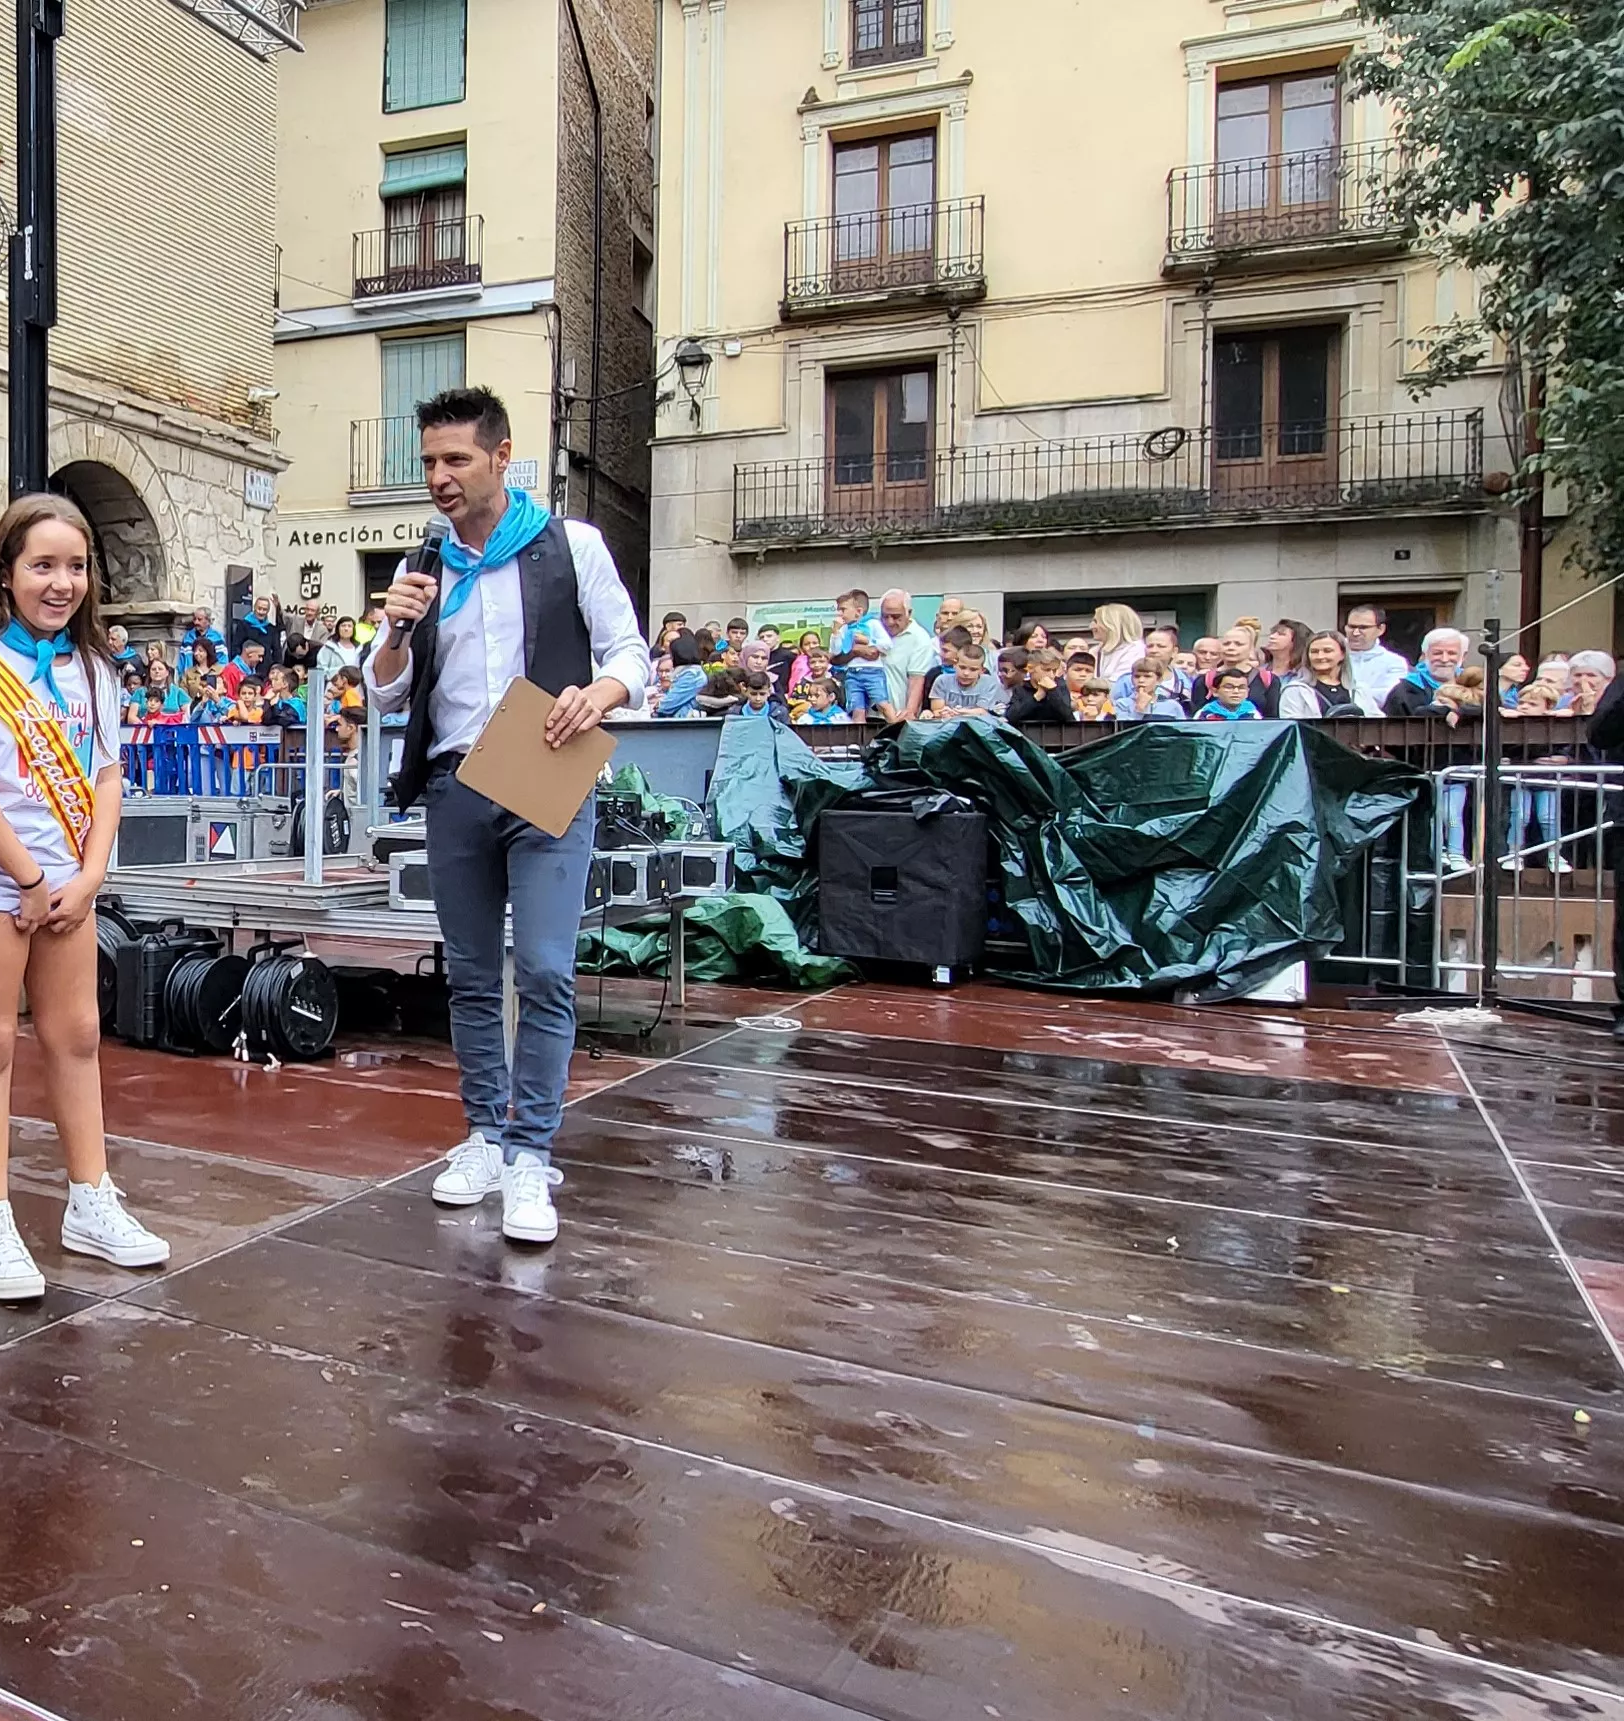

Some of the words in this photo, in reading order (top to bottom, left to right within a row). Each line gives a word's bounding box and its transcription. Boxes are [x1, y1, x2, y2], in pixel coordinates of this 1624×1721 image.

[508, 463, 531, 474] CALLE
[506, 475, 532, 487] AYOR
[288, 525, 383, 546] Atención
[393, 523, 427, 540] Ciu
[284, 603, 337, 616] Moón
